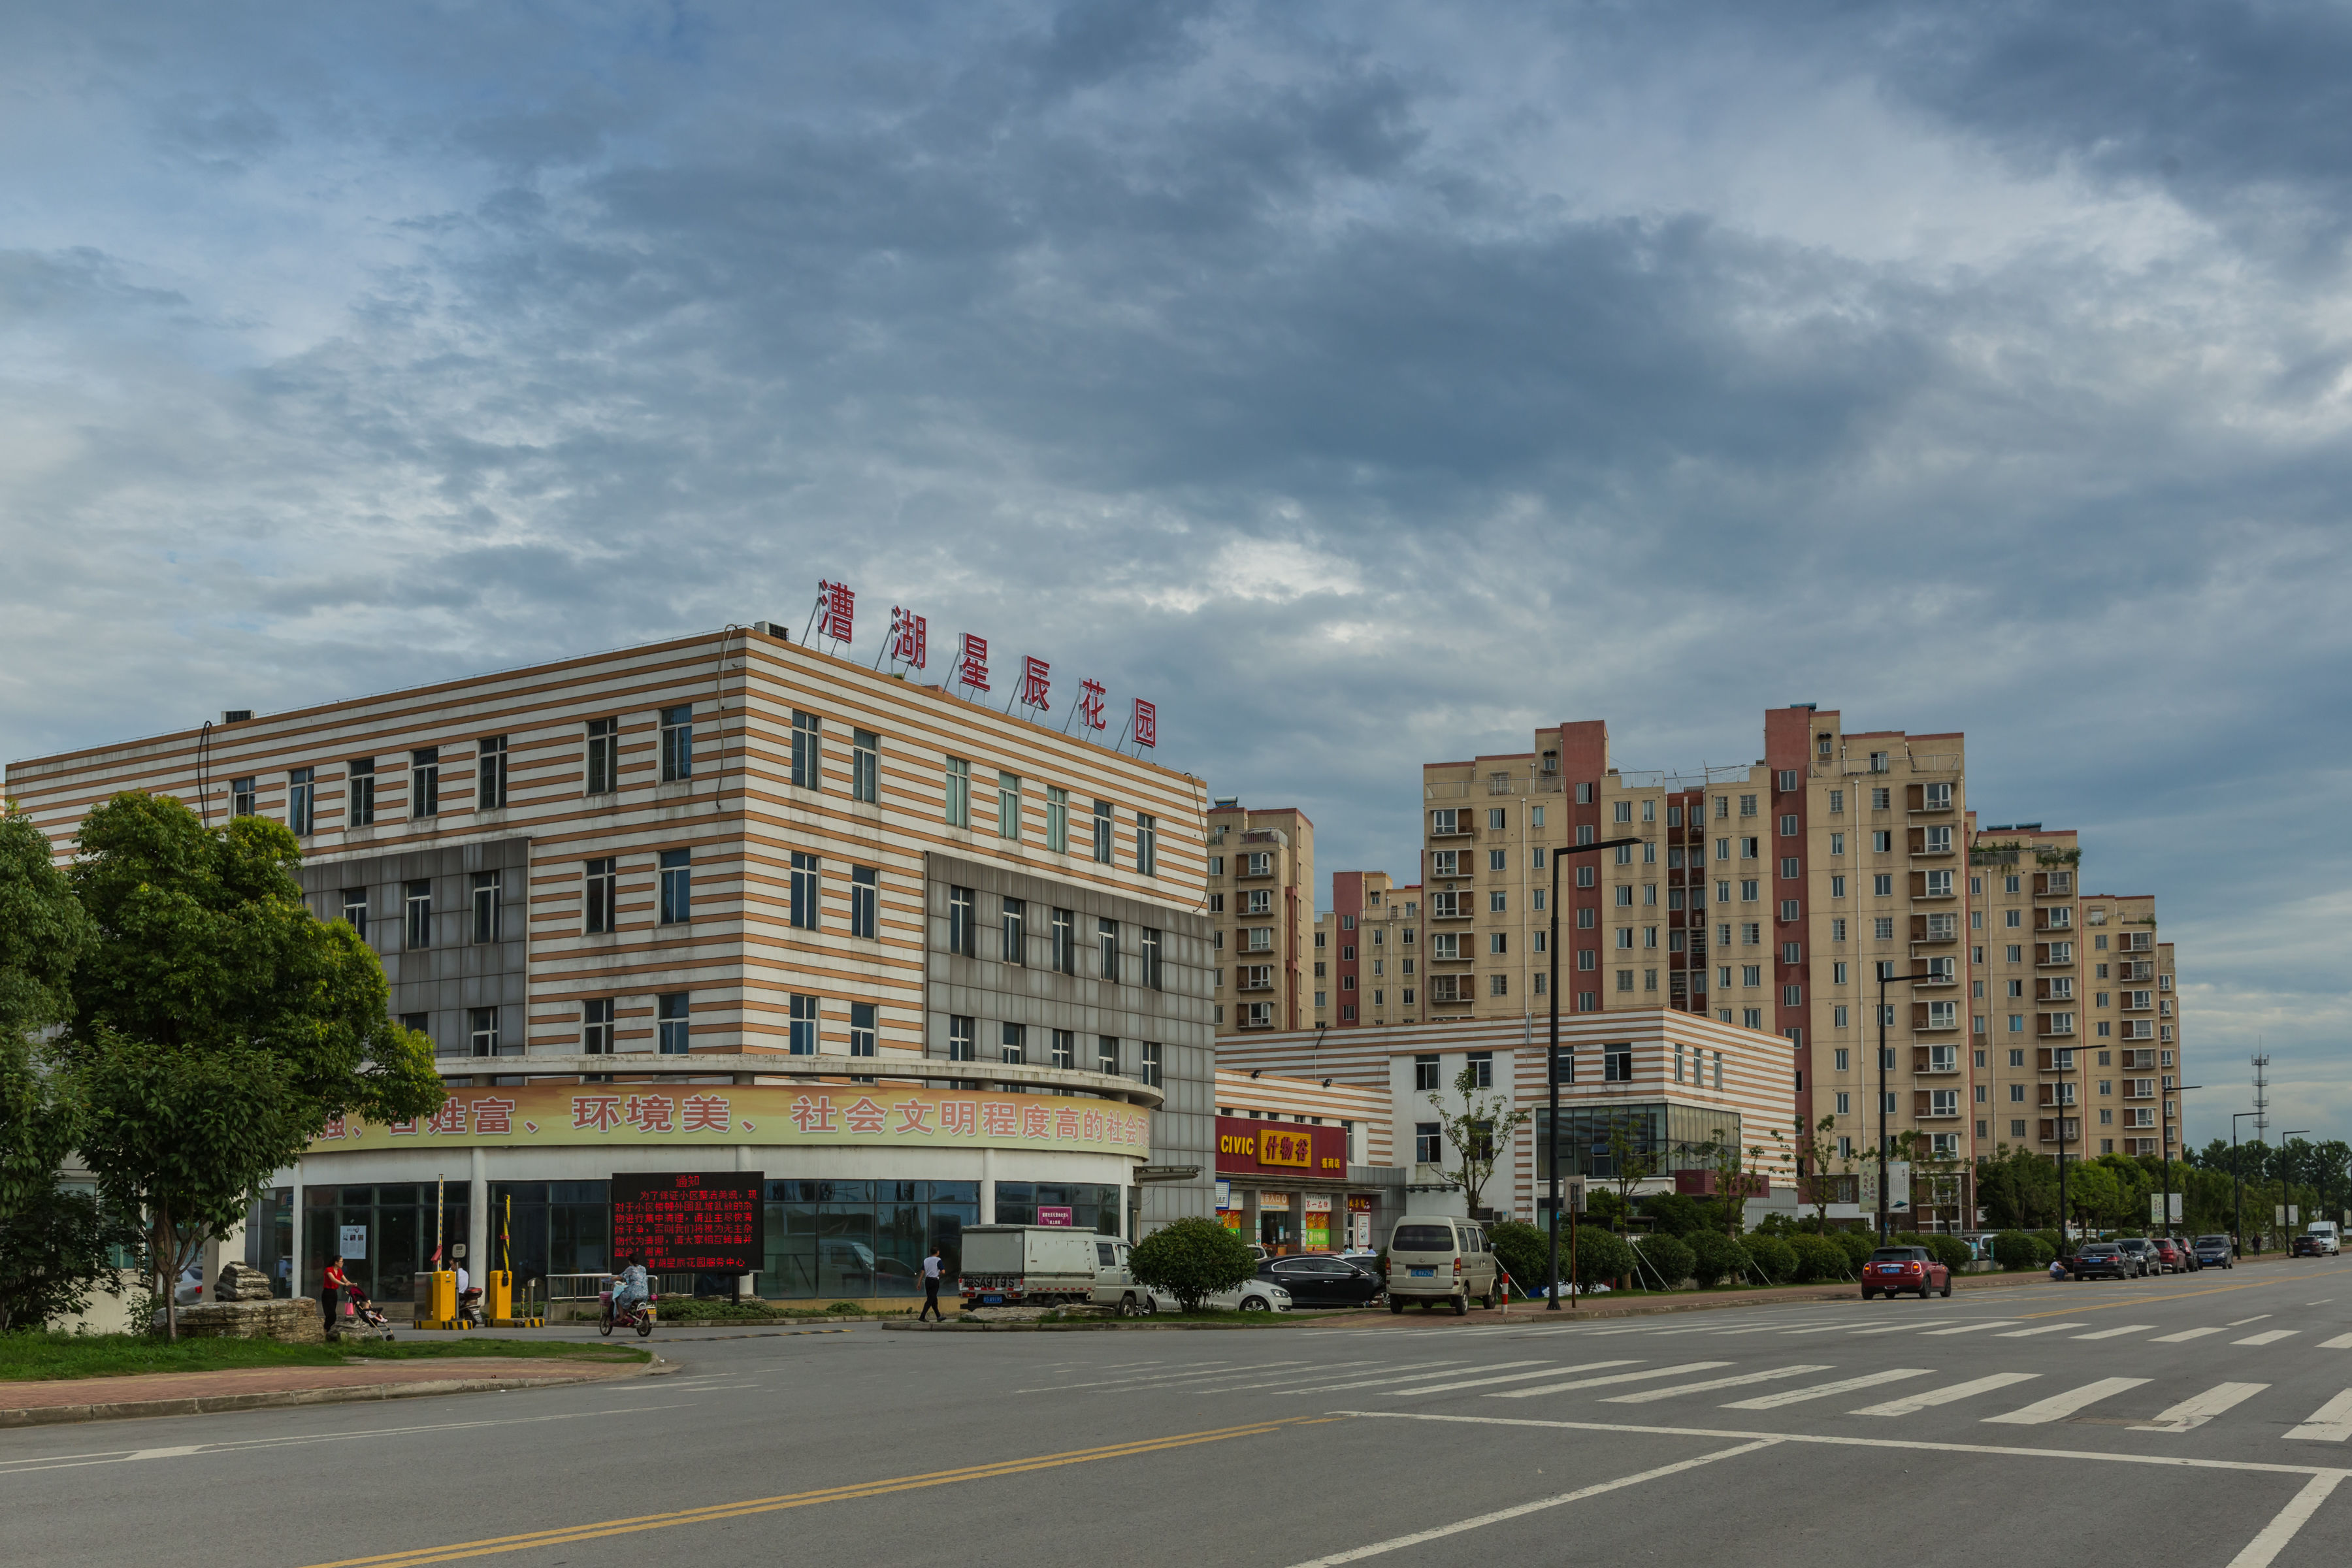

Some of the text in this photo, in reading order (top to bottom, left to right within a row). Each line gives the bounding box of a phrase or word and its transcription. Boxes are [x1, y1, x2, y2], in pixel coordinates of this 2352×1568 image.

[817, 578, 1156, 748] 漕湖星辰花园
[306, 1094, 1150, 1150] 强、姓富、环境美、社会文明程度高的社会而
[1220, 1135, 1254, 1155] CIVIC
[1266, 1135, 1308, 1162] 什物谷
[676, 1175, 700, 1188] 通知
[646, 1257, 745, 1268] 漕湖星辰花园服务中心
